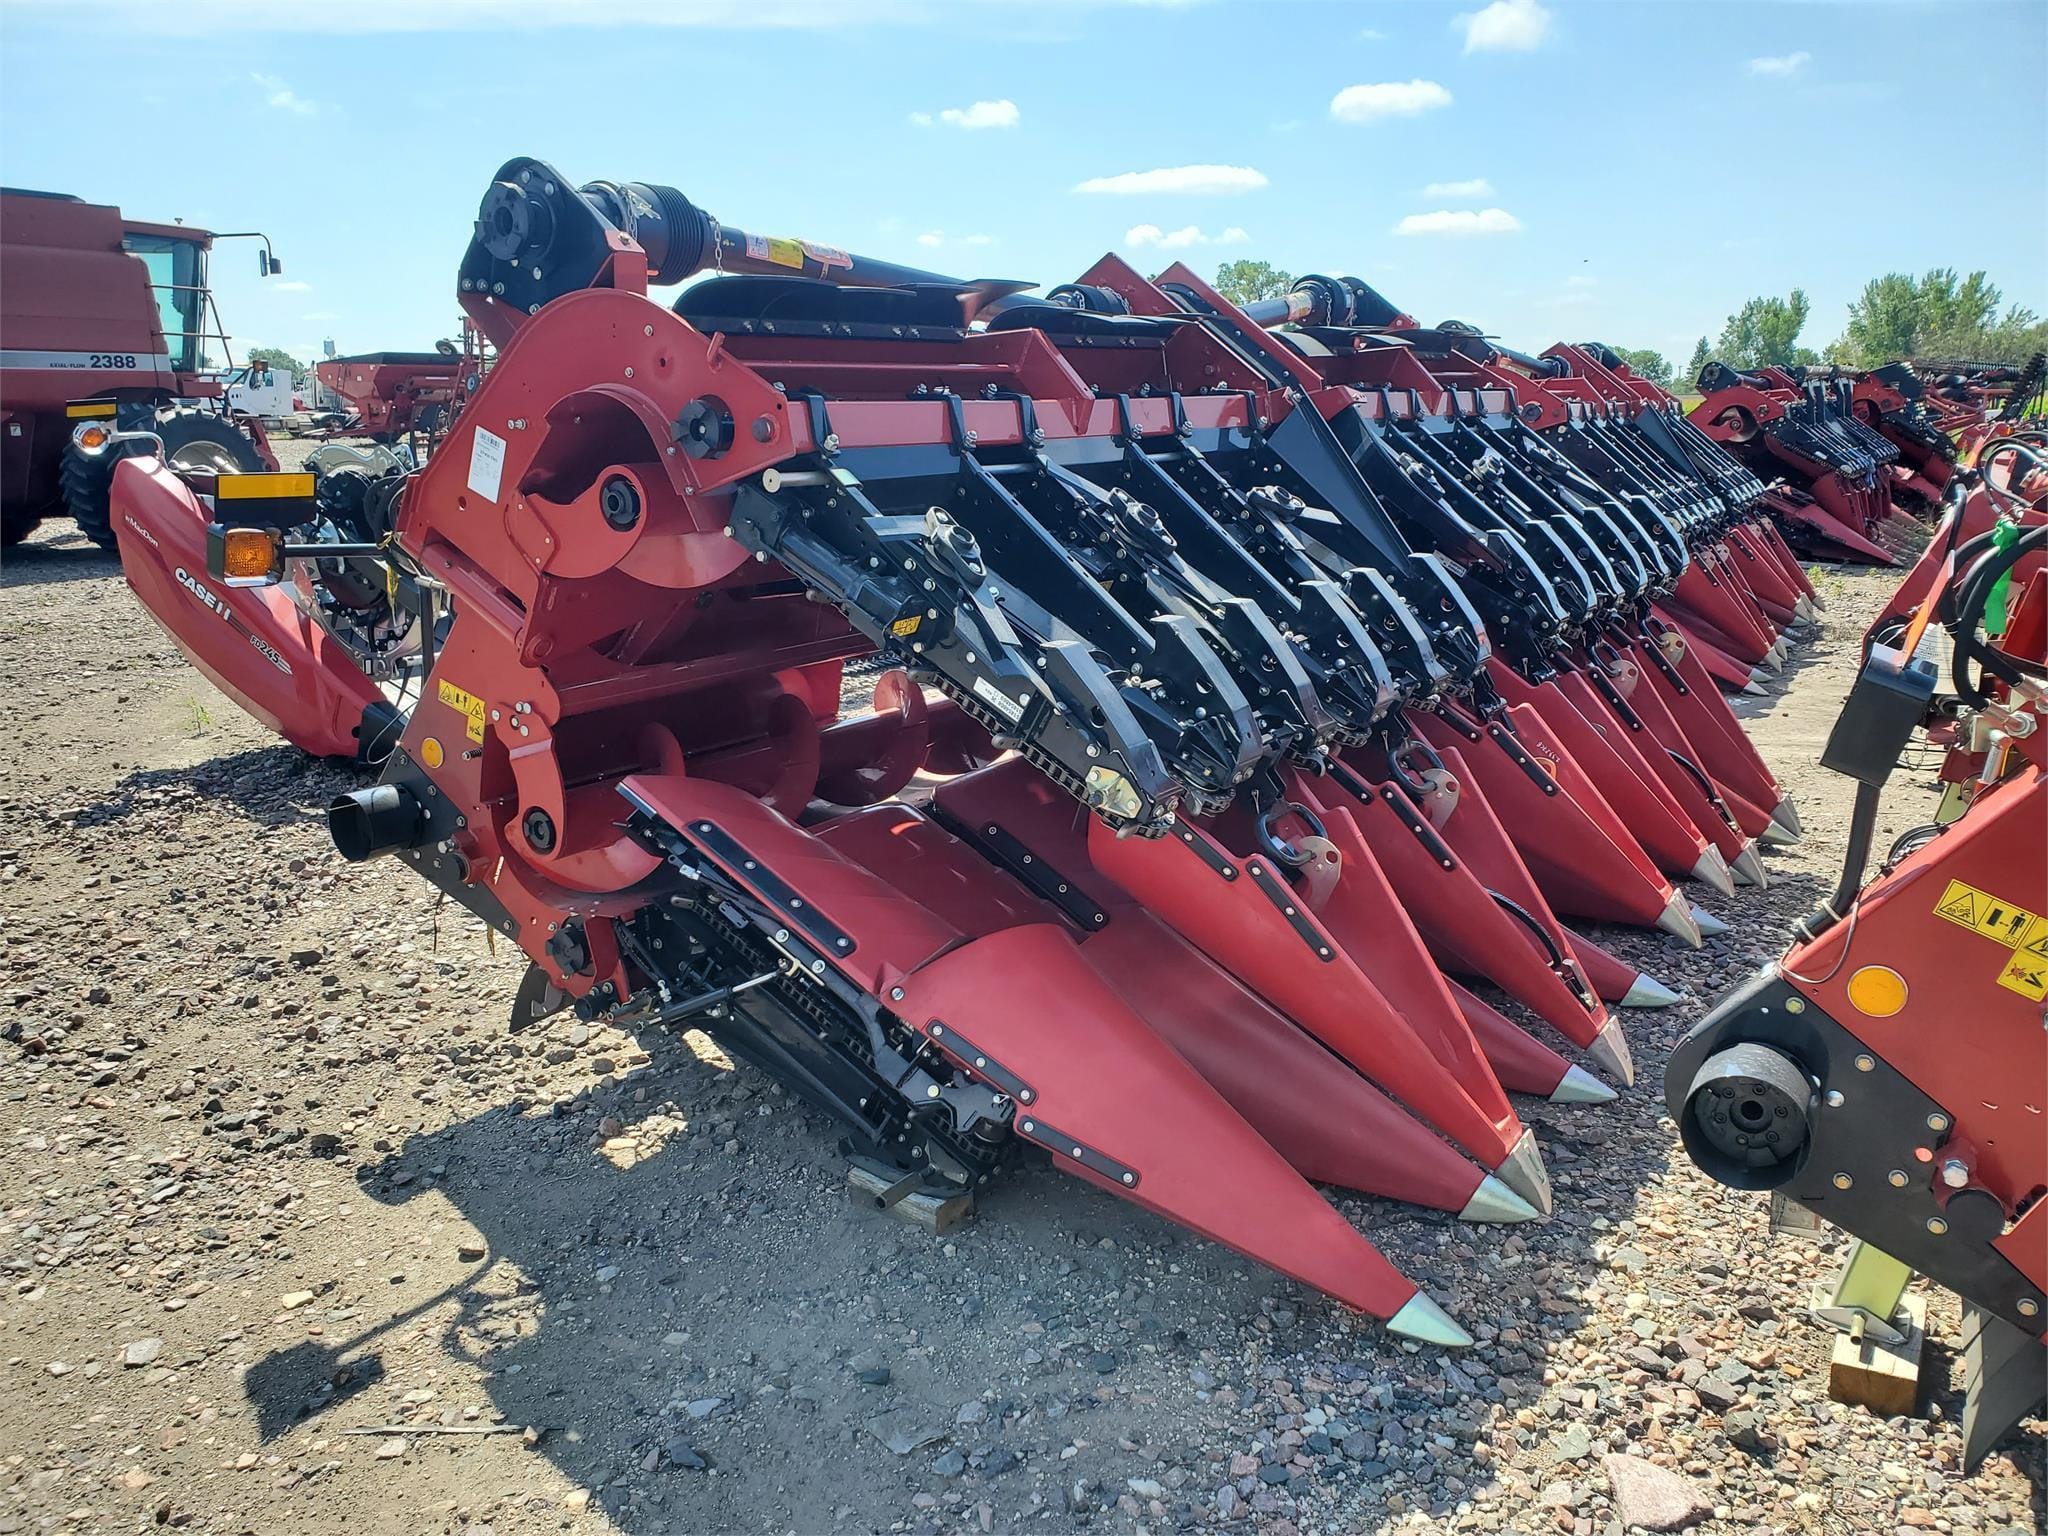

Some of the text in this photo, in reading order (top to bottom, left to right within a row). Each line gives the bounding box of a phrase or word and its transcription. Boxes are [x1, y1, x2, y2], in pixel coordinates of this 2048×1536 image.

[90, 355, 137, 369] 2388
[175, 567, 217, 609] CASE
[250, 635, 281, 664] FD245
